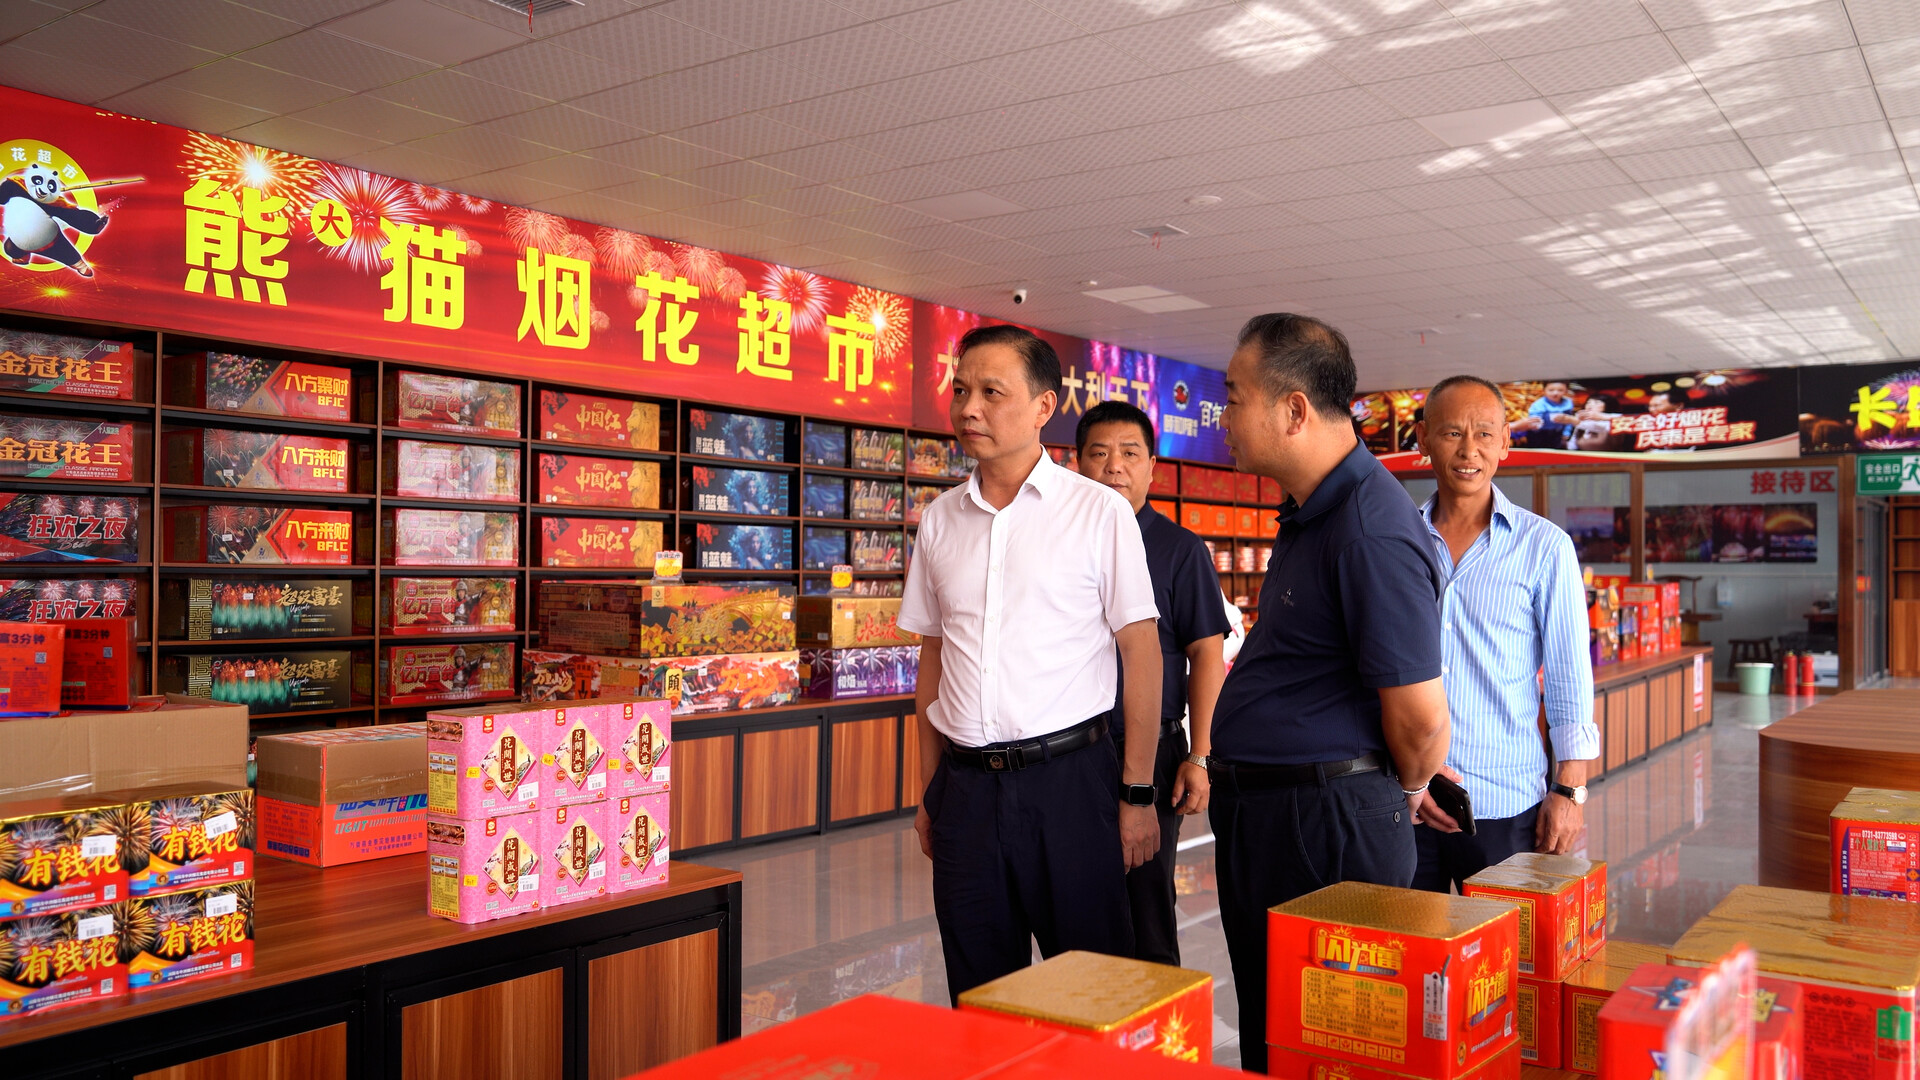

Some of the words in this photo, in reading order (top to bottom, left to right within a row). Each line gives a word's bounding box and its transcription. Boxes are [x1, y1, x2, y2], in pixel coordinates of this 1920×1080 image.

[316, 203, 344, 236] 大
[0, 351, 123, 384] 金冠花王
[284, 372, 349, 397] 八方聚财
[317, 395, 345, 408] BFJC
[575, 403, 622, 432] 中国红
[1611, 407, 1727, 433] 安全好烟花
[0, 437, 122, 466] 金冠花王
[281, 446, 346, 468] 八方来财
[312, 467, 345, 479] BFLC
[575, 465, 622, 493] 中国红
[1751, 470, 1836, 494] 接待区
[28, 513, 128, 540] 狂欢之夜
[285, 520, 351, 540] 八方来财
[316, 540, 348, 552] BFLC
[577, 527, 625, 555] 中国红
[28, 598, 127, 623] 狂欢之夜
[335, 820, 368, 834] LIGHT
[157, 912, 248, 957] 有钱花
[17, 936, 119, 983] 有钱花
